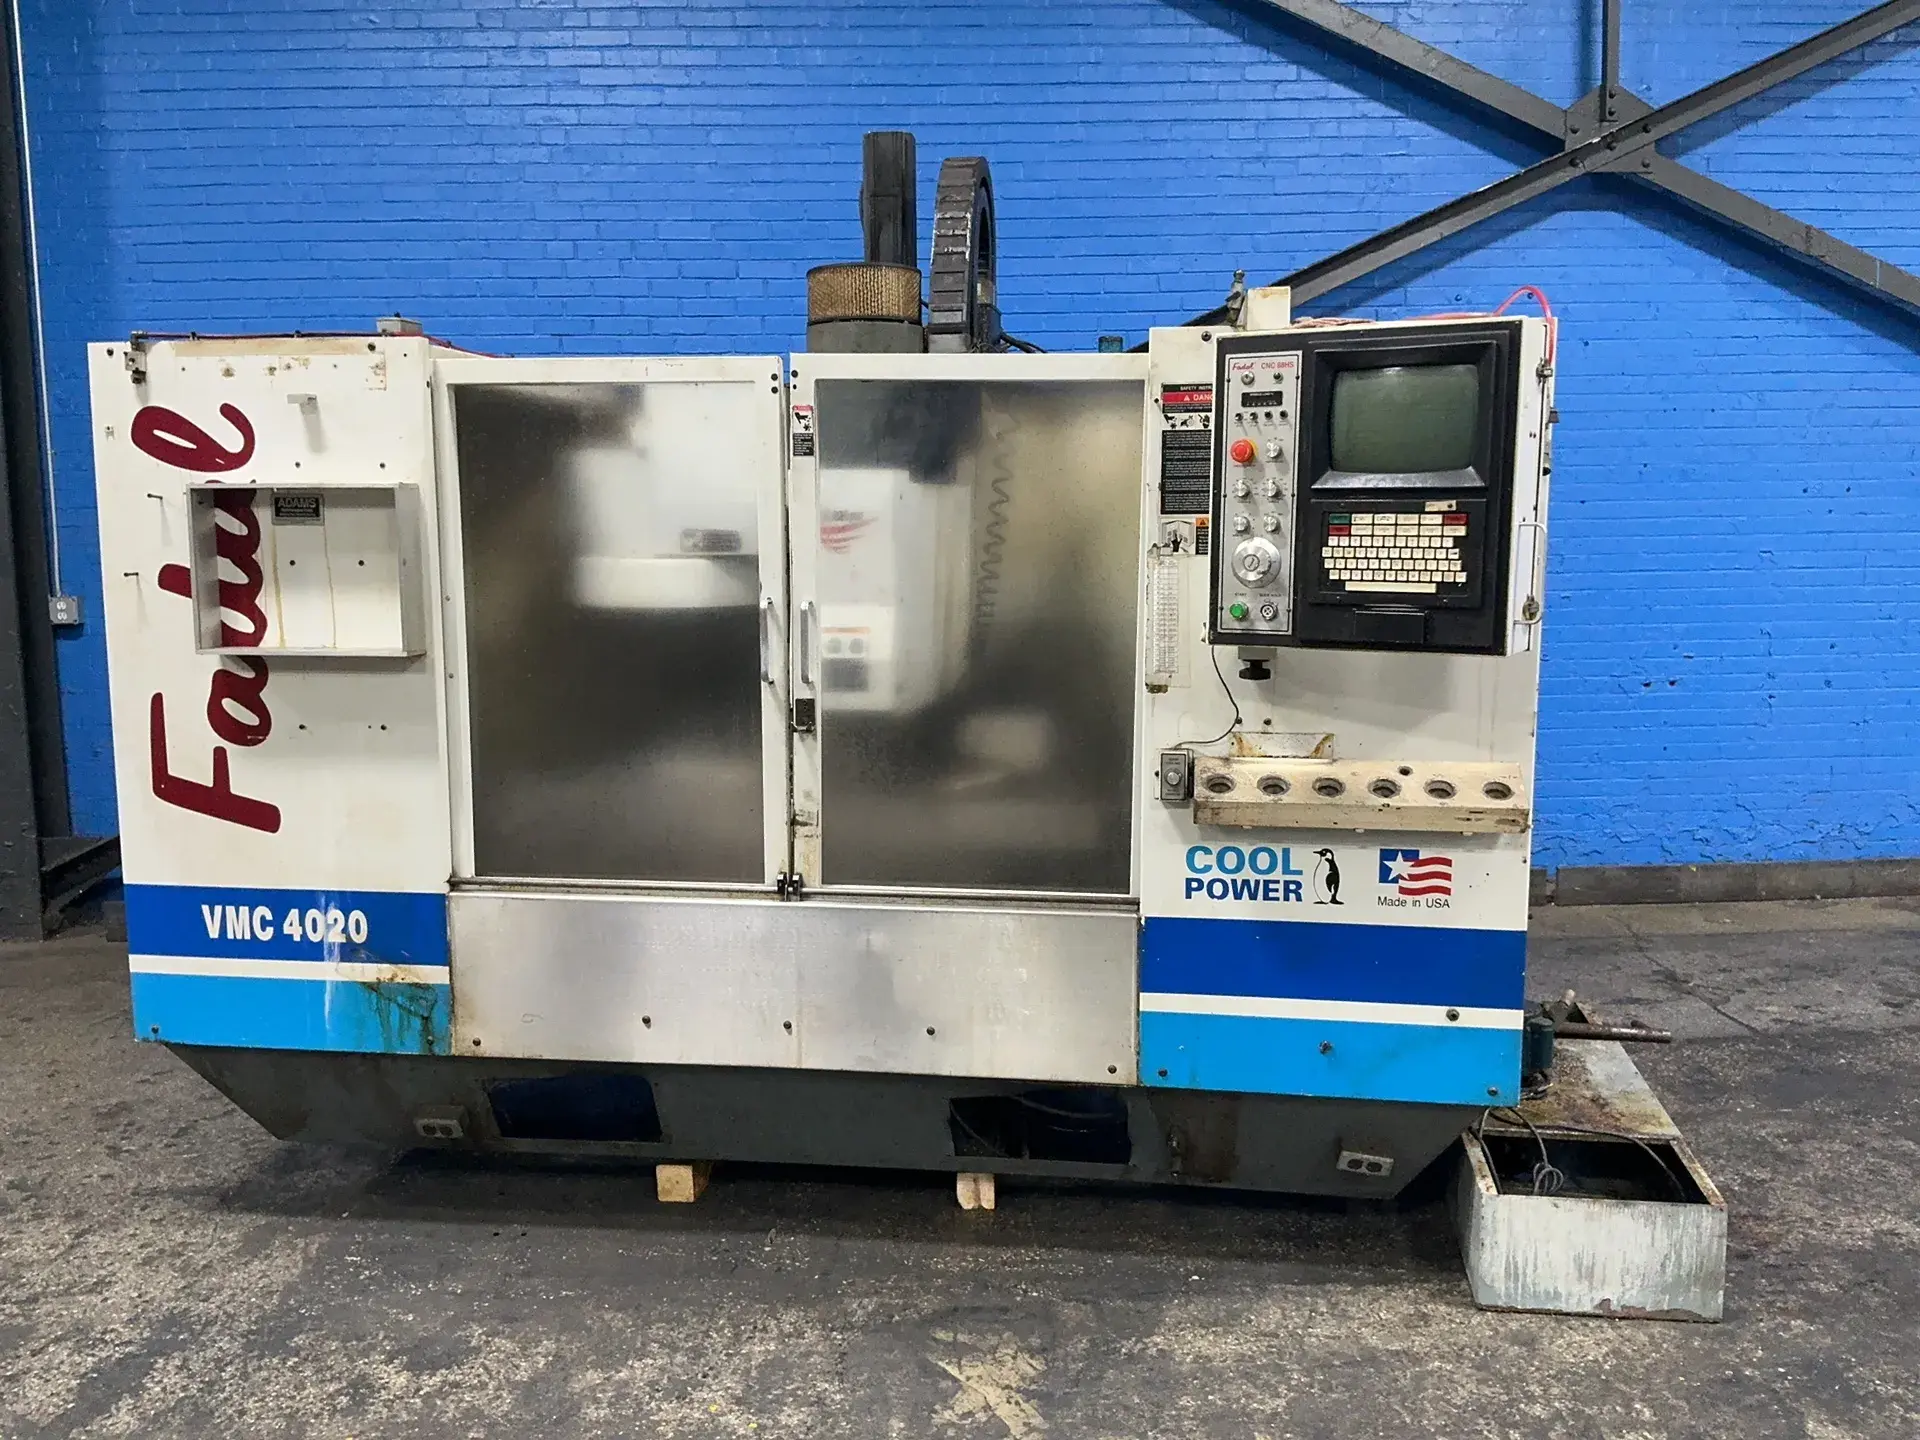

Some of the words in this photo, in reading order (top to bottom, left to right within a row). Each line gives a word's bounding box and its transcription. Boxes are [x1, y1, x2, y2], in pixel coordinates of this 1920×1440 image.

[278, 497, 316, 508] ADAMS
[1185, 845, 1303, 876] COOL
[1185, 877, 1303, 902] POWER
[1377, 896, 1406, 907] Made
[1411, 897, 1421, 907] in
[1426, 898, 1450, 909] USA
[201, 905, 274, 942] VMC
[283, 908, 368, 944] 4020
